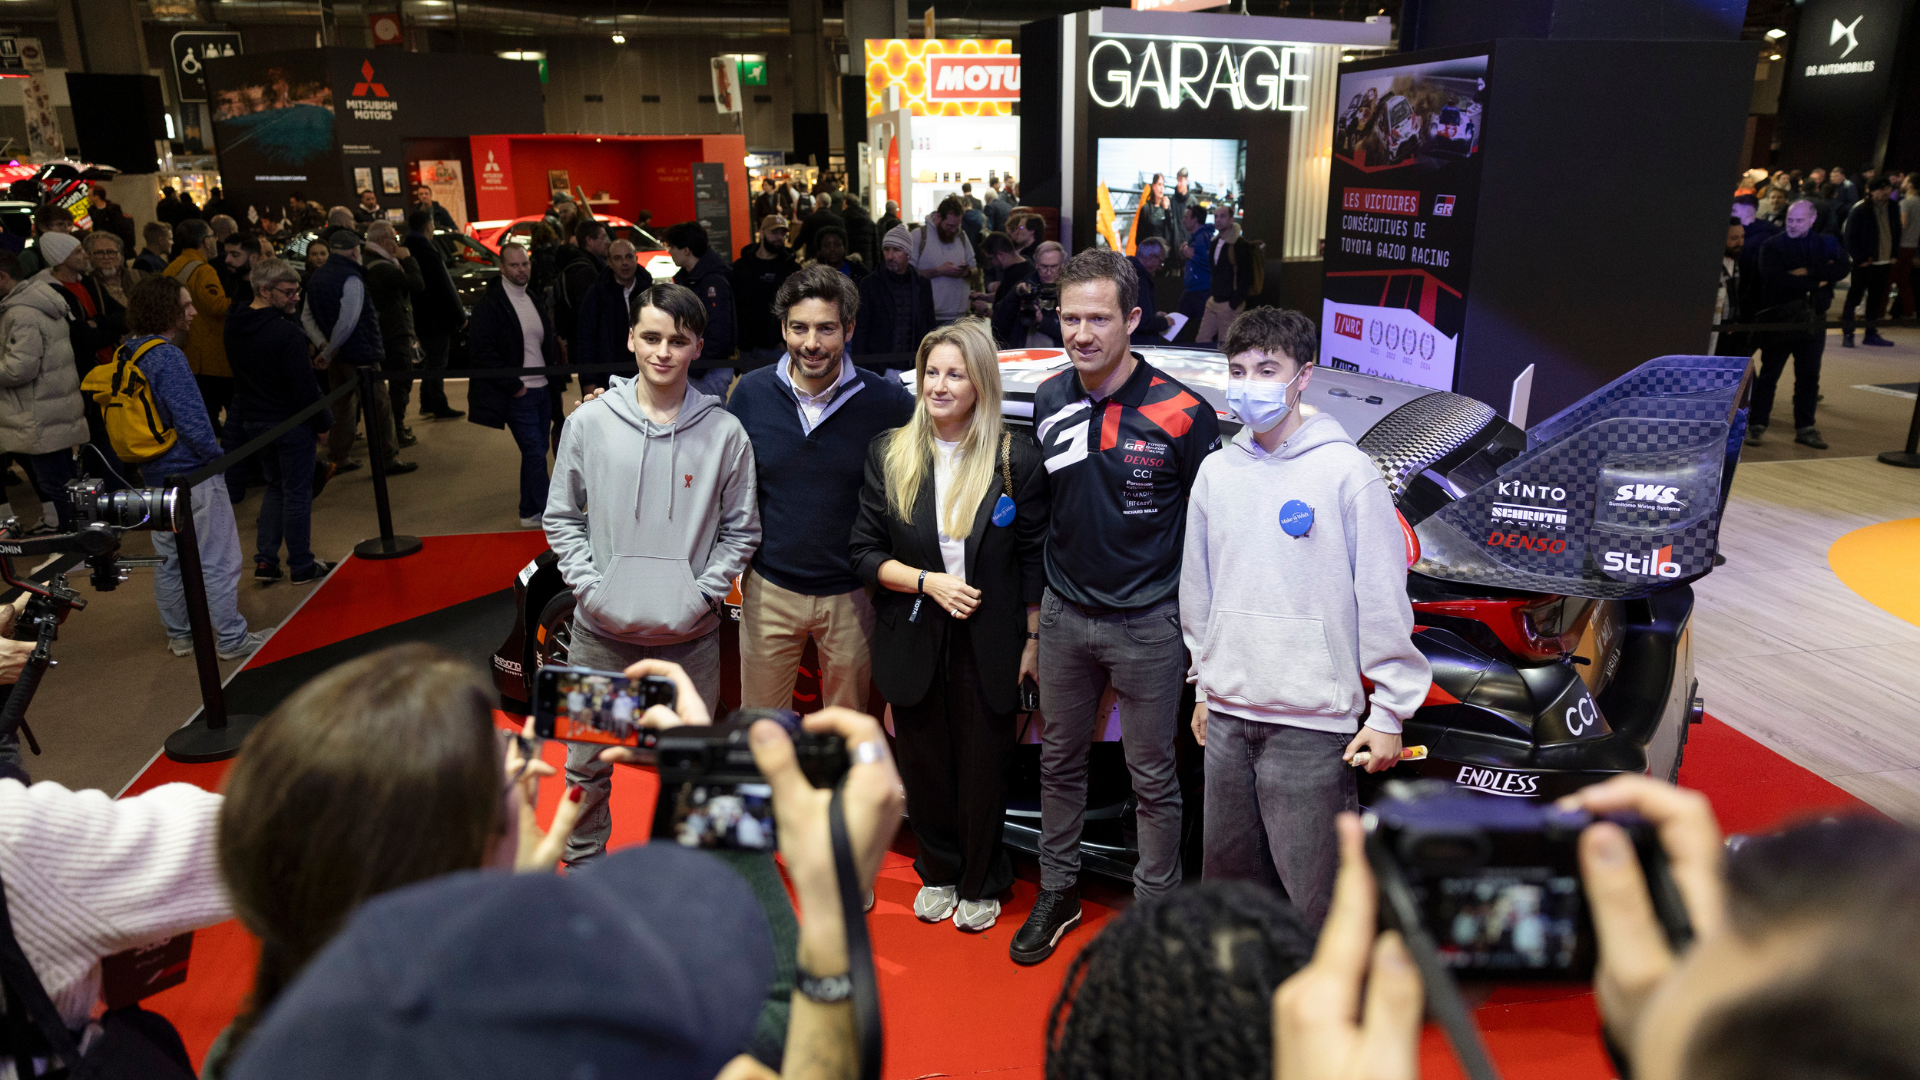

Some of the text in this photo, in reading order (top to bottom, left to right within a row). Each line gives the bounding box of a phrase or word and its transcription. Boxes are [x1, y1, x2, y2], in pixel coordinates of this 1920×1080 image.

[1088, 39, 1311, 111] GARAGE
[1805, 60, 1876, 77] DS AUTOMOBILES
[346, 99, 398, 111] MITSUBISHI
[354, 110, 393, 120] MOTORS
[1344, 192, 1416, 212] LES VICTOIRES
[1434, 204, 1454, 214] GR
[1342, 214, 1426, 239] CONSÉCUTIVES DE
[1341, 237, 1450, 268] TOYOTA GAZOO RACING
[1124, 443, 1144, 452] GR
[1124, 454, 1164, 467] DENSO
[1133, 469, 1152, 478] CCi
[1615, 484, 1680, 504] SWS
[1490, 518, 1566, 531] RACING
[1492, 507, 1568, 525] SCHROTH
[1487, 532, 1566, 554] DENSO
[1604, 546, 1681, 578] Stilo
[1565, 692, 1598, 736] CCi
[1456, 766, 1540, 794] ENDLESS
